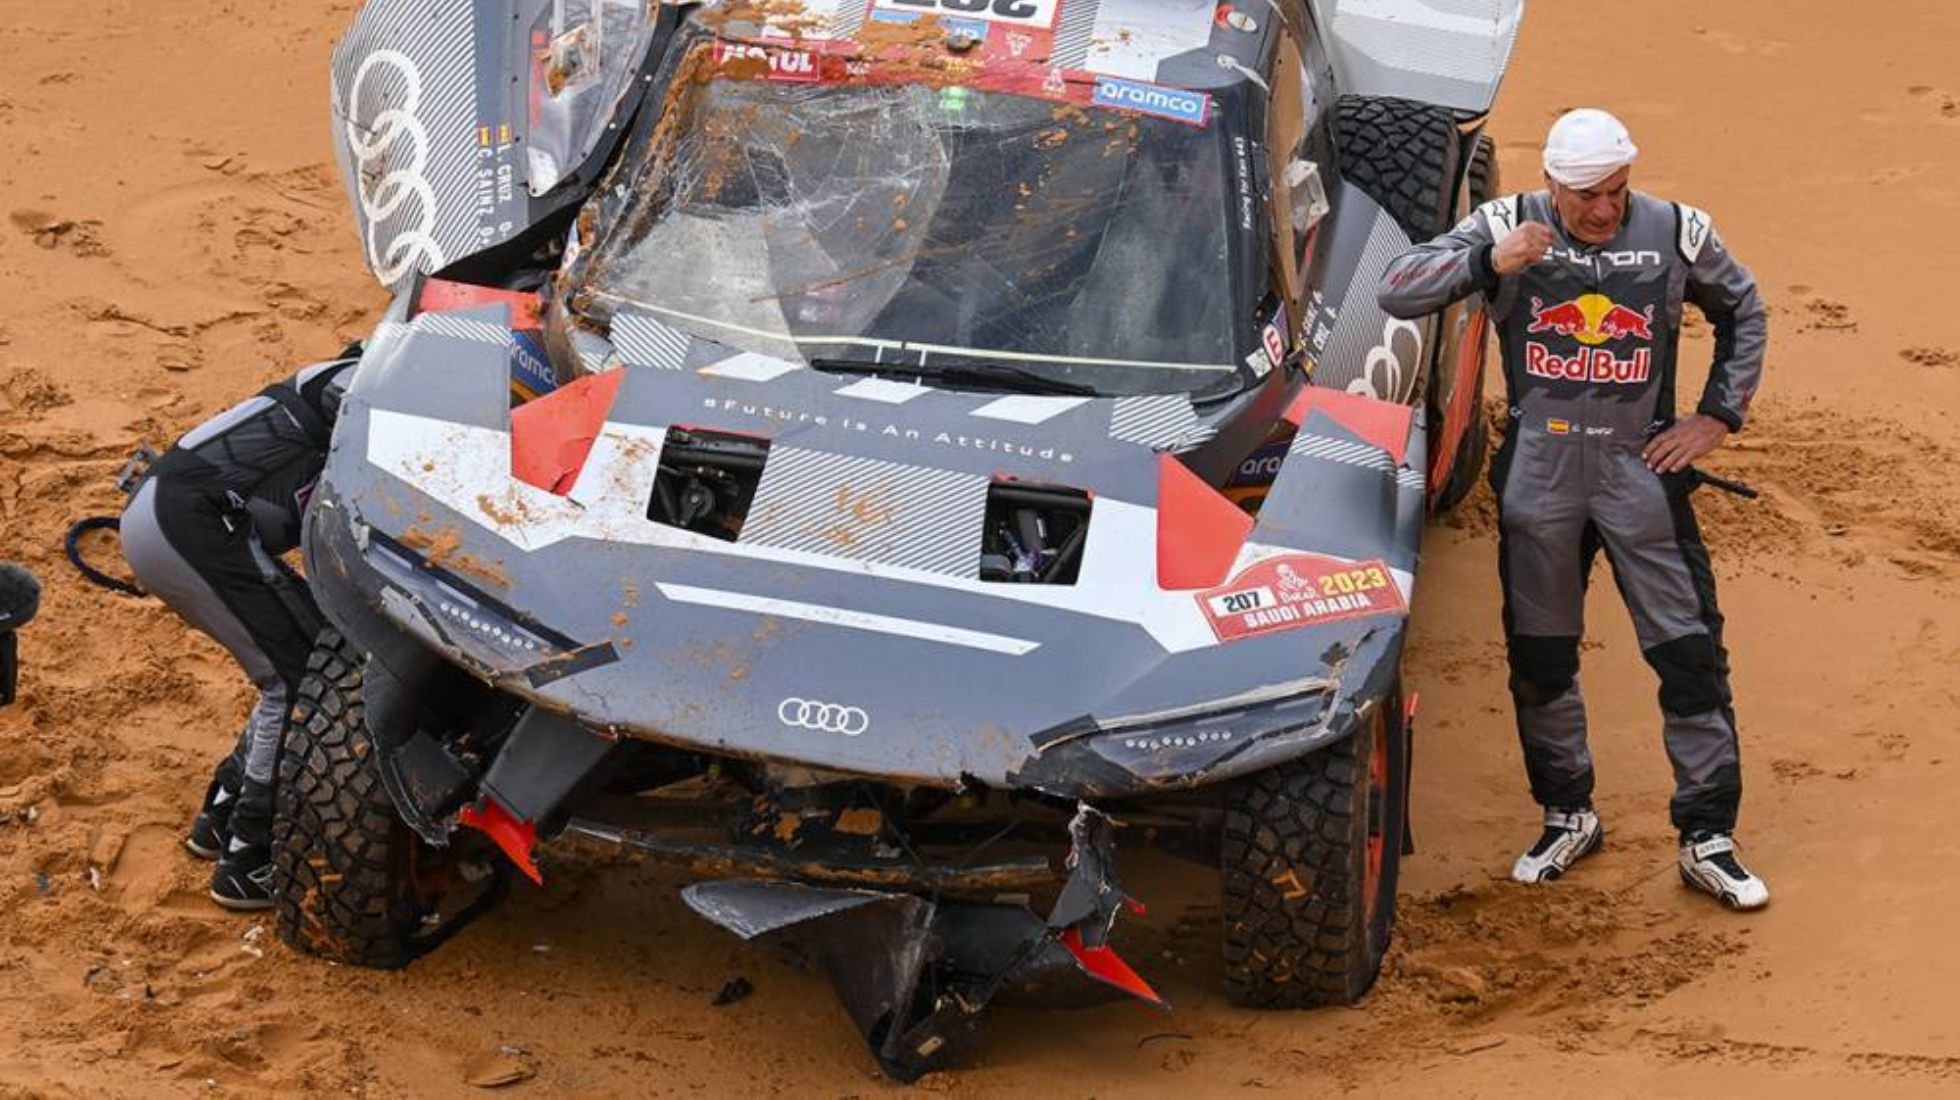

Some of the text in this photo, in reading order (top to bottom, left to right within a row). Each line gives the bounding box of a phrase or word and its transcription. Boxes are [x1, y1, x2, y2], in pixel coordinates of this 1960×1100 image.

[1101, 83, 1197, 113] aramco
[479, 168, 495, 217] SAINZ
[497, 164, 512, 203] CRUZ
[510, 343, 559, 388] ramc
[1527, 341, 1650, 382] Red Bull
[705, 398, 827, 426] #Future
[882, 424, 919, 440] An
[934, 432, 1073, 462] Attitude
[1319, 567, 1387, 595] 2023
[1223, 591, 1262, 613] 207
[1244, 592, 1372, 628] SAUDI ARABIA
